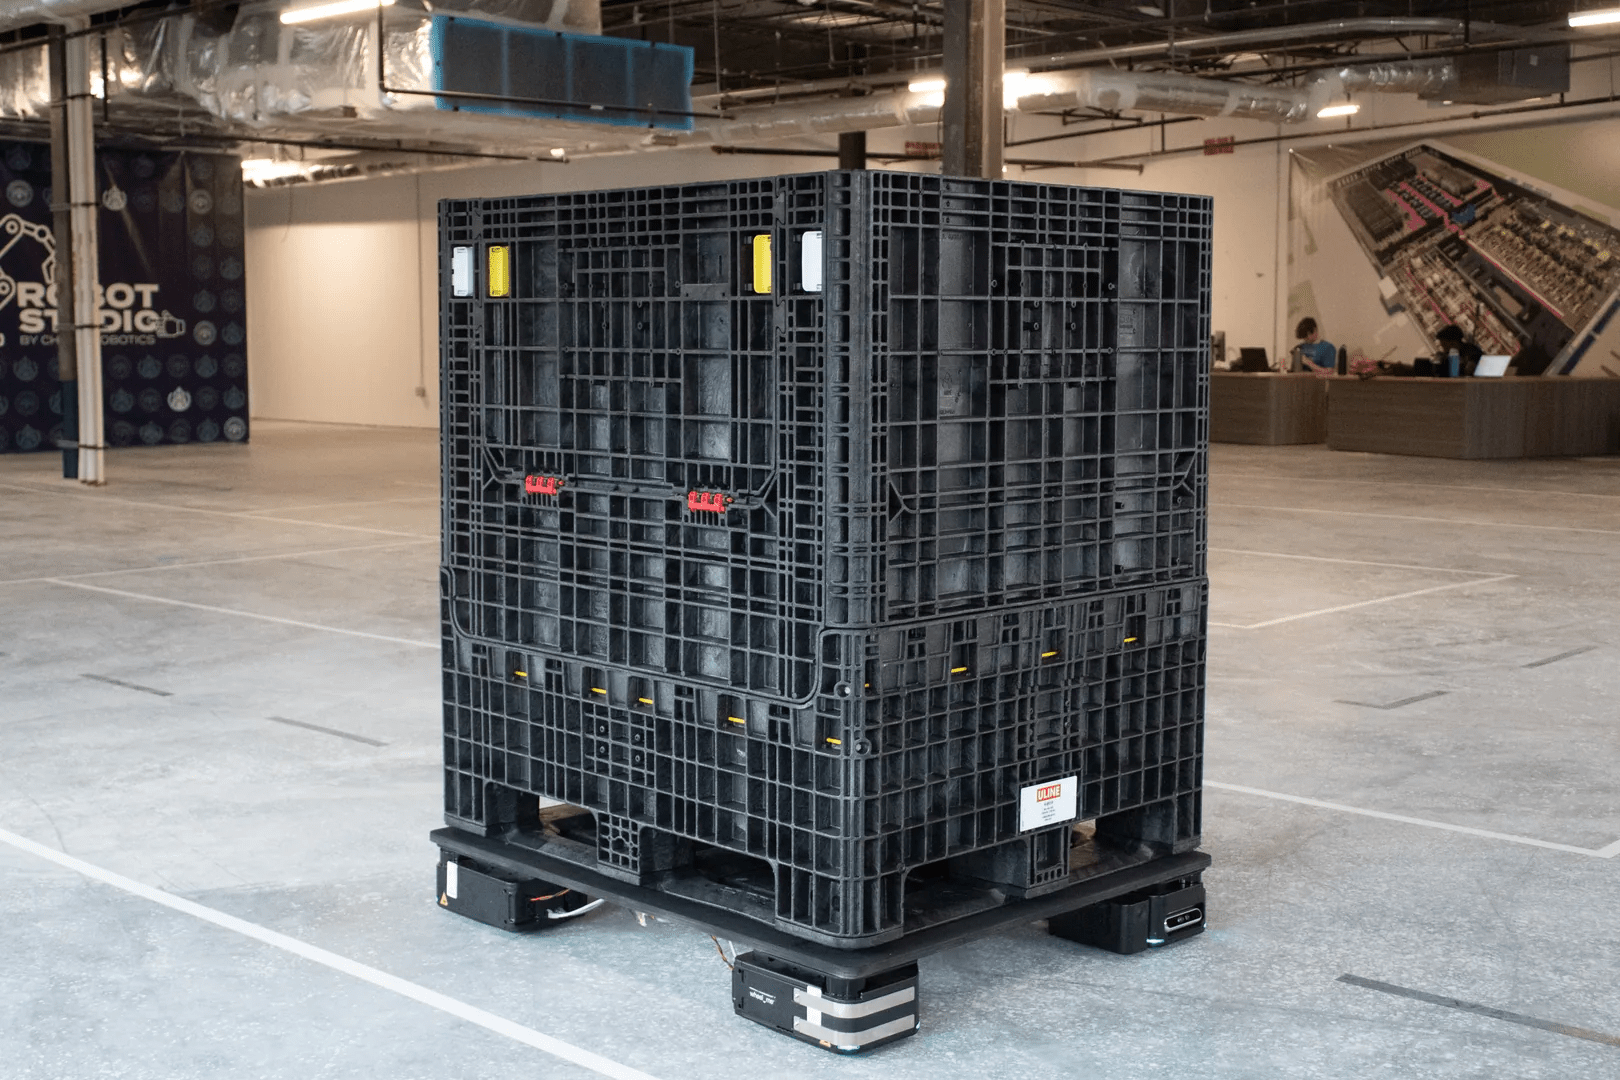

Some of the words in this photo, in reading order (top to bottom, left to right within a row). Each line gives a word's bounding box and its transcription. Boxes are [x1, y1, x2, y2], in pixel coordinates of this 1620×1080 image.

[17, 282, 159, 309] ROT
[19, 308, 160, 333] STDIO
[20, 335, 38, 345] BY
[100, 334, 156, 346] OBOTICS
[1037, 784, 1061, 802] ULINE
